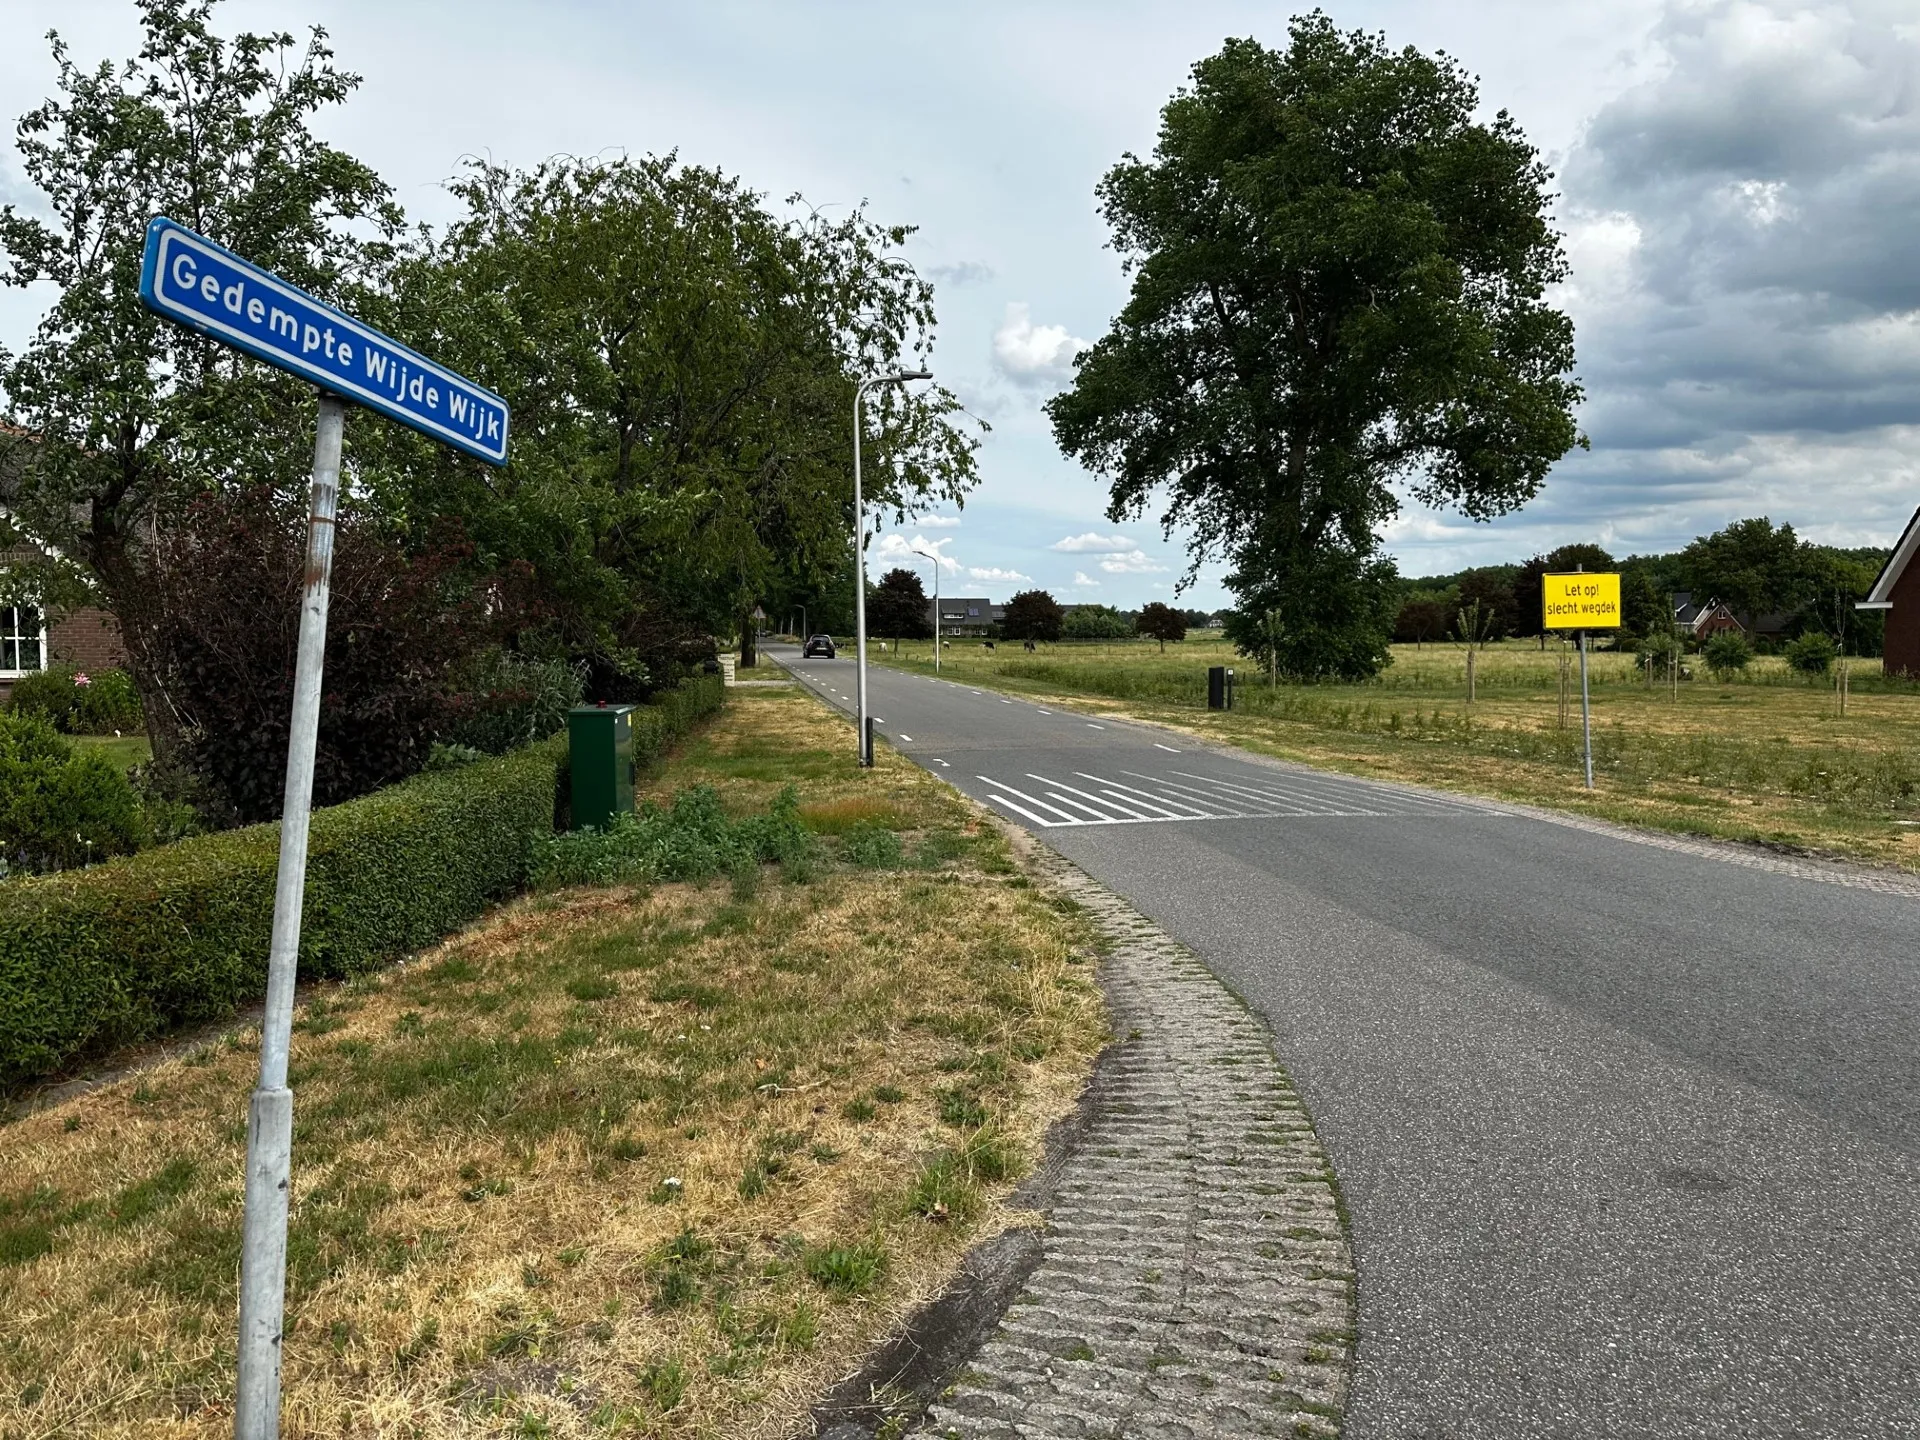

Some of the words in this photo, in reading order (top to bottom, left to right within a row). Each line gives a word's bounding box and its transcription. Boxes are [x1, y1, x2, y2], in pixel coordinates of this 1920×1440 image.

[172, 254, 352, 366] Gedempte
[365, 347, 439, 408] Wijde
[448, 390, 499, 440] Wijk
[1565, 584, 1581, 596] Let
[1584, 584, 1599, 597] op!
[1547, 602, 1577, 614] slecht
[1581, 601, 1616, 615] wegdek
